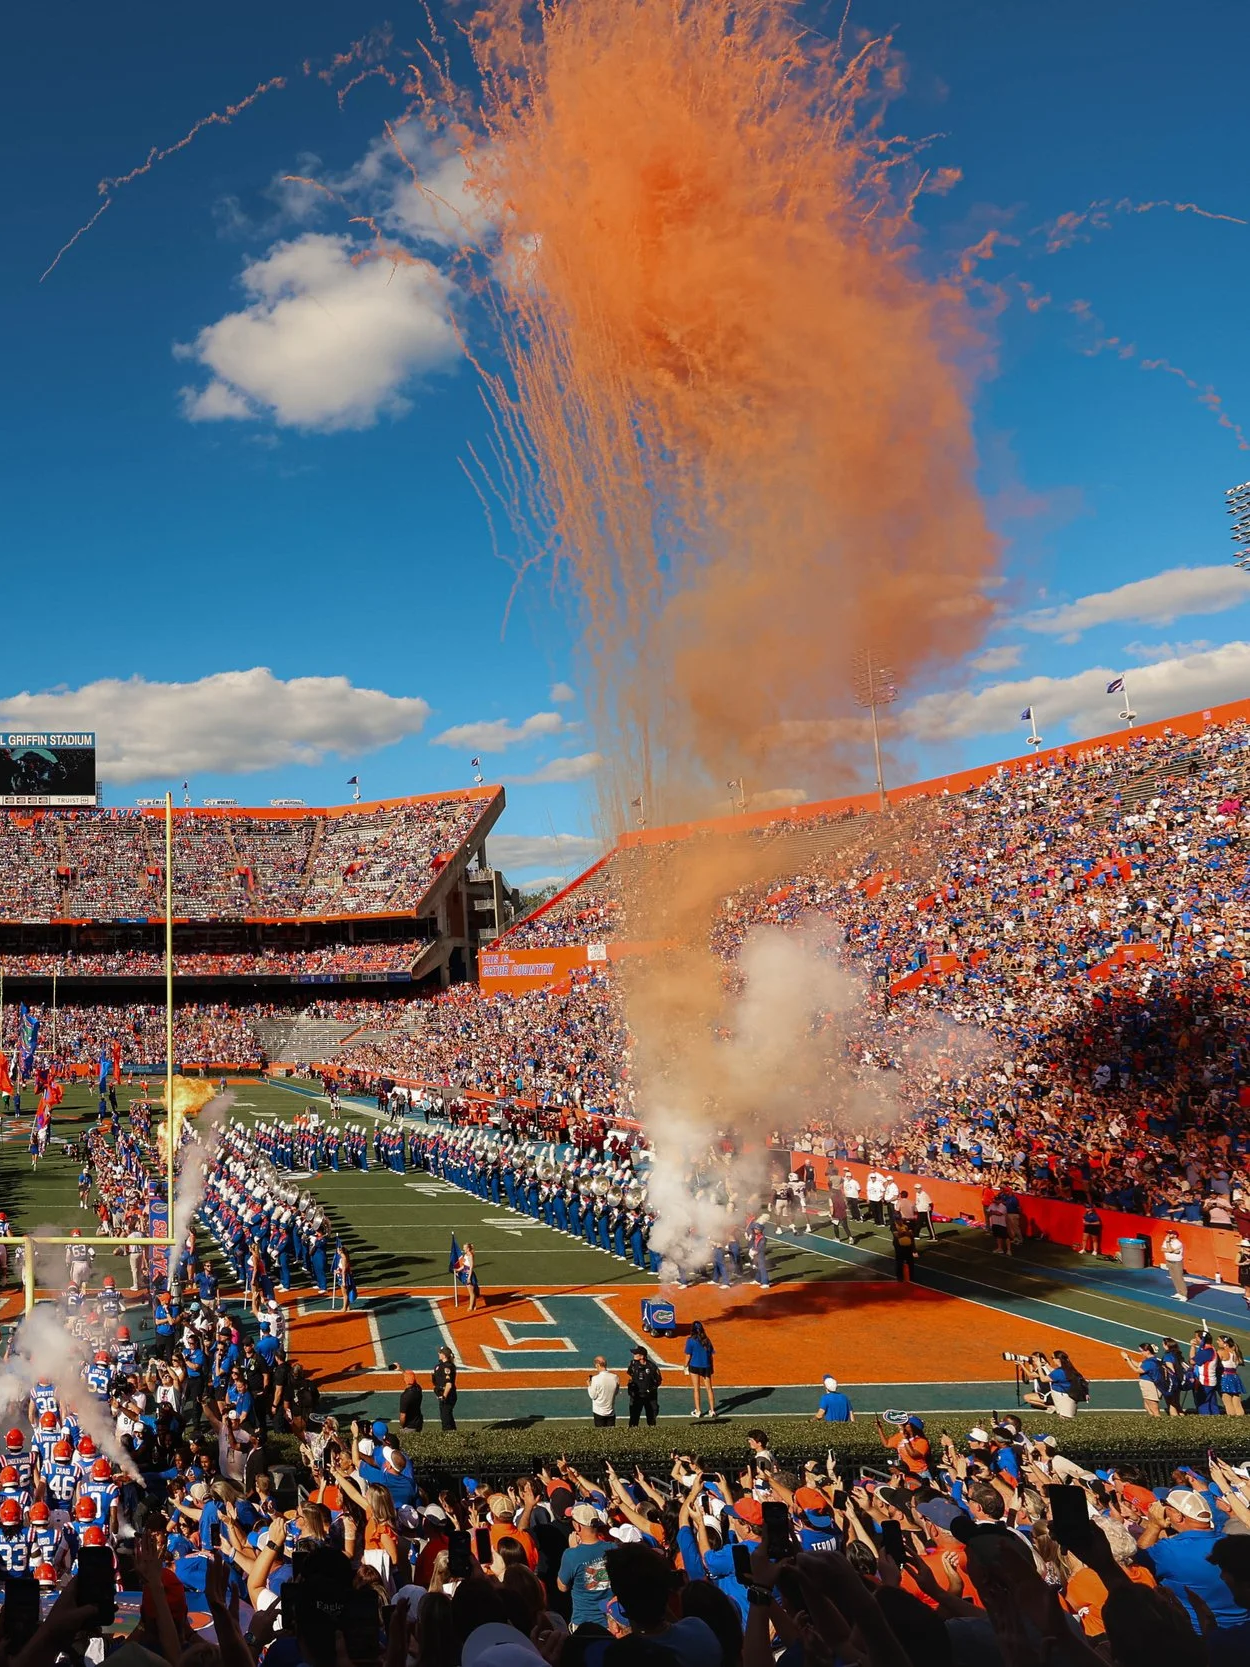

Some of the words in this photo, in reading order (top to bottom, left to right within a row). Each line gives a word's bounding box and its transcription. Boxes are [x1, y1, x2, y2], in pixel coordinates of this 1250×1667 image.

[9, 735, 47, 745] GRIFFIN
[50, 735, 92, 745] STADIUM
[482, 955, 499, 964] THIS
[482, 965, 509, 977] GATOR
[512, 963, 555, 976] COUNTRY
[71, 1244, 86, 1257] 63
[88, 1374, 108, 1394] 53
[36, 1397, 58, 1414] 30
[56, 1467, 70, 1475] CRAIG
[49, 1475, 75, 1500] 46
